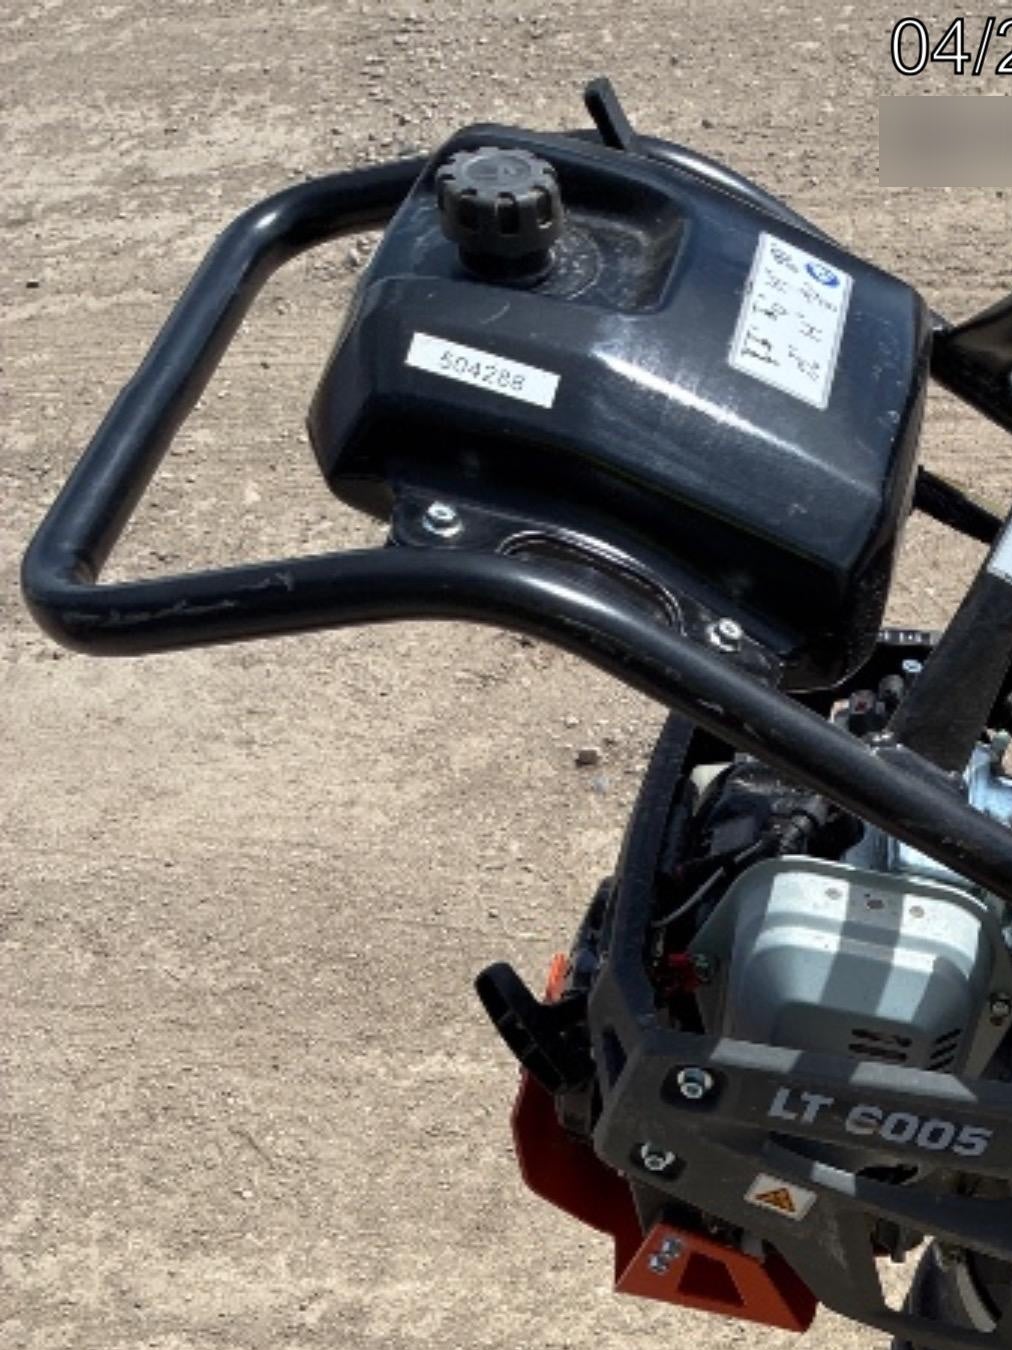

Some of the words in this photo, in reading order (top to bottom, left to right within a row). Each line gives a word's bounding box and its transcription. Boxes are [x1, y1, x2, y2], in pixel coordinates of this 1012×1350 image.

[440, 350, 526, 391] 504288
[768, 1086, 835, 1123] LT
[846, 1104, 994, 1156] 6005
